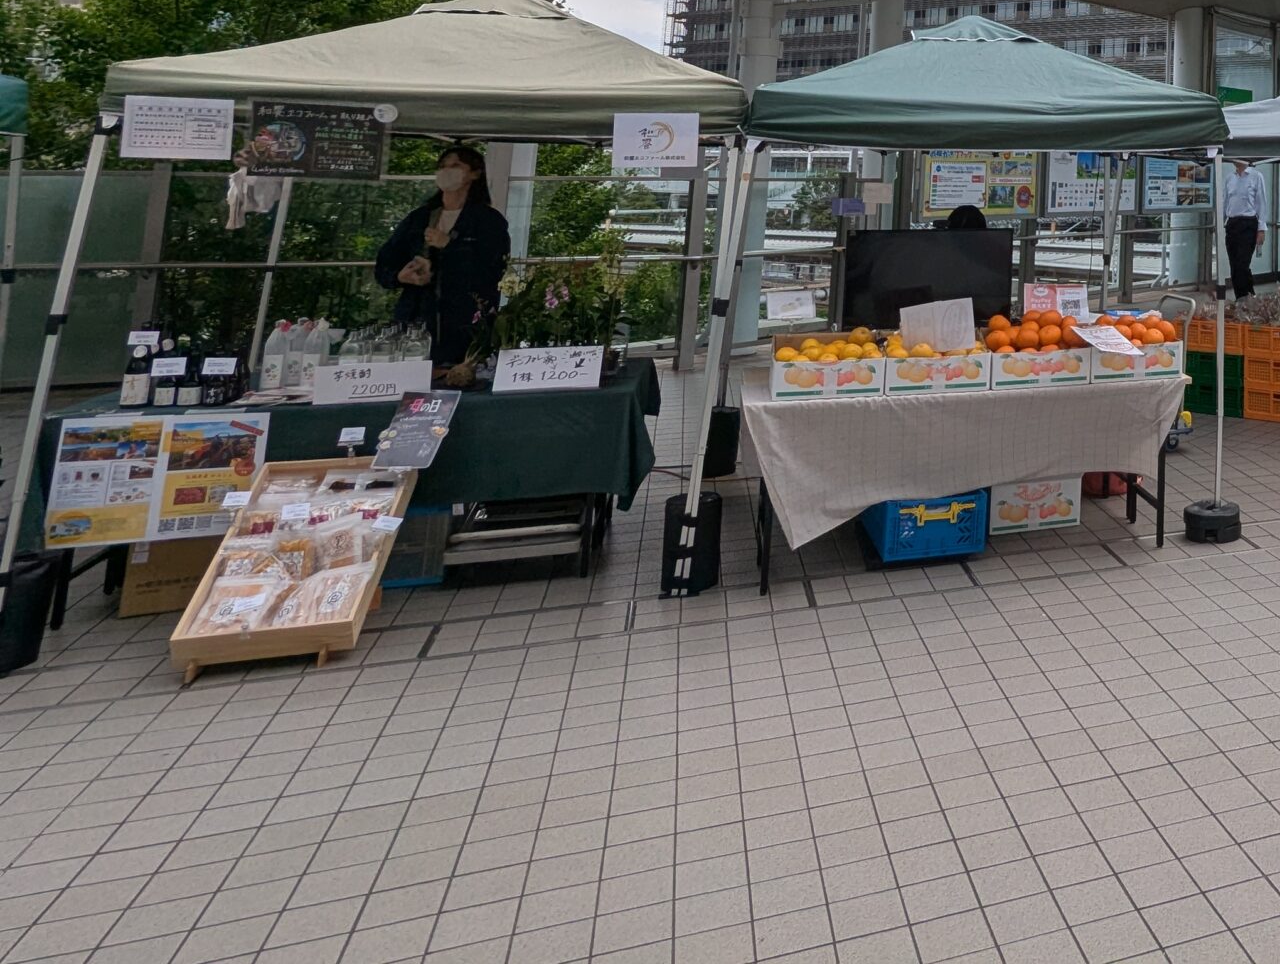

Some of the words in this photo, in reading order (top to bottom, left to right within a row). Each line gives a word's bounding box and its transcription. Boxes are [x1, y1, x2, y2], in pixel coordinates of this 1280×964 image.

[333, 368, 372, 382] 芋焼酎
[512, 372, 534, 383] 1株
[352, 383, 397, 396] 2200円
[409, 398, 442, 414] 母の日
